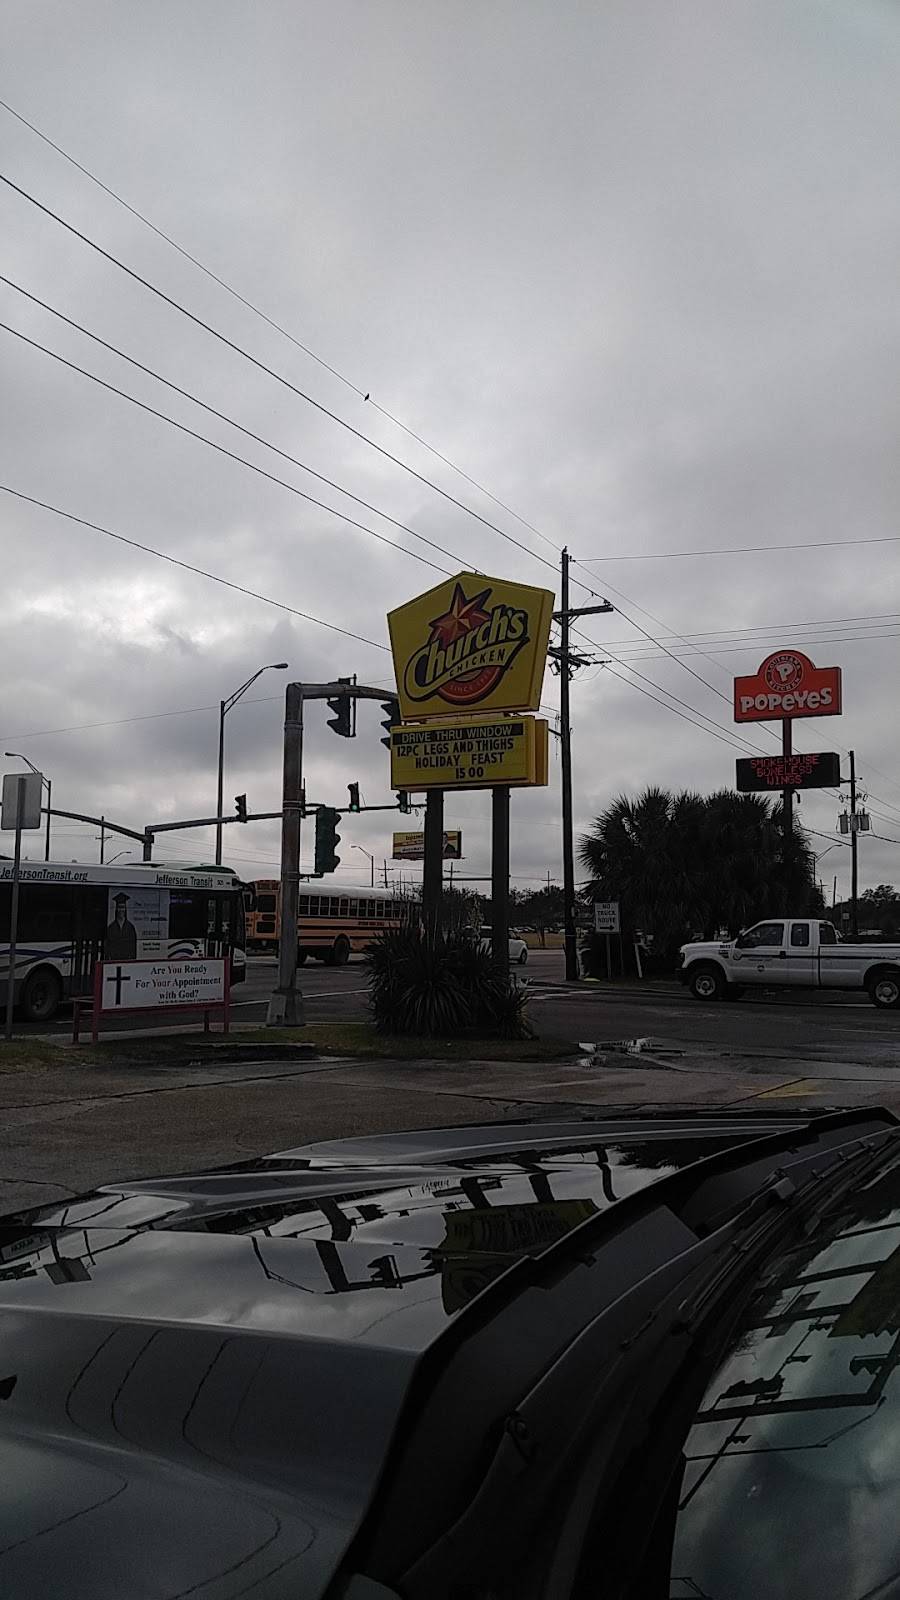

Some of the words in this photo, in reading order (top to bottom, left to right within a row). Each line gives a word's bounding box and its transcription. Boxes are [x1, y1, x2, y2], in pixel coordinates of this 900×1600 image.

[404, 604, 529, 702] Church's
[449, 648, 505, 677] CHICKEN
[402, 731, 431, 743] DRIVE
[436, 728, 463, 742] THRU
[466, 725, 513, 739] WINDOW
[397, 745, 419, 757] 12PC
[424, 743, 449, 756] LEGS
[453, 740, 474, 753] AND
[477, 738, 514, 750] THIGHS
[415, 755, 461, 768] HOLIDAY
[471, 752, 505, 765] FEAST
[751, 754, 818, 768] SMOKEHOUSE
[756, 765, 812, 778] BONELESS
[767, 774, 802, 786] WINGS
[1, 866, 88, 881] JefersonTransit.org
[155, 874, 188, 885] Jefferson
[190, 875, 213, 887] Transit
[150, 967, 166, 975] Are
[168, 966, 181, 975] You
[184, 965, 208, 975] Ready
[135, 980, 150, 988] For
[152, 979, 171, 988] Your
[172, 977, 221, 988] Appointment
[159, 991, 177, 1000] with
[178, 989, 199, 999] God?
